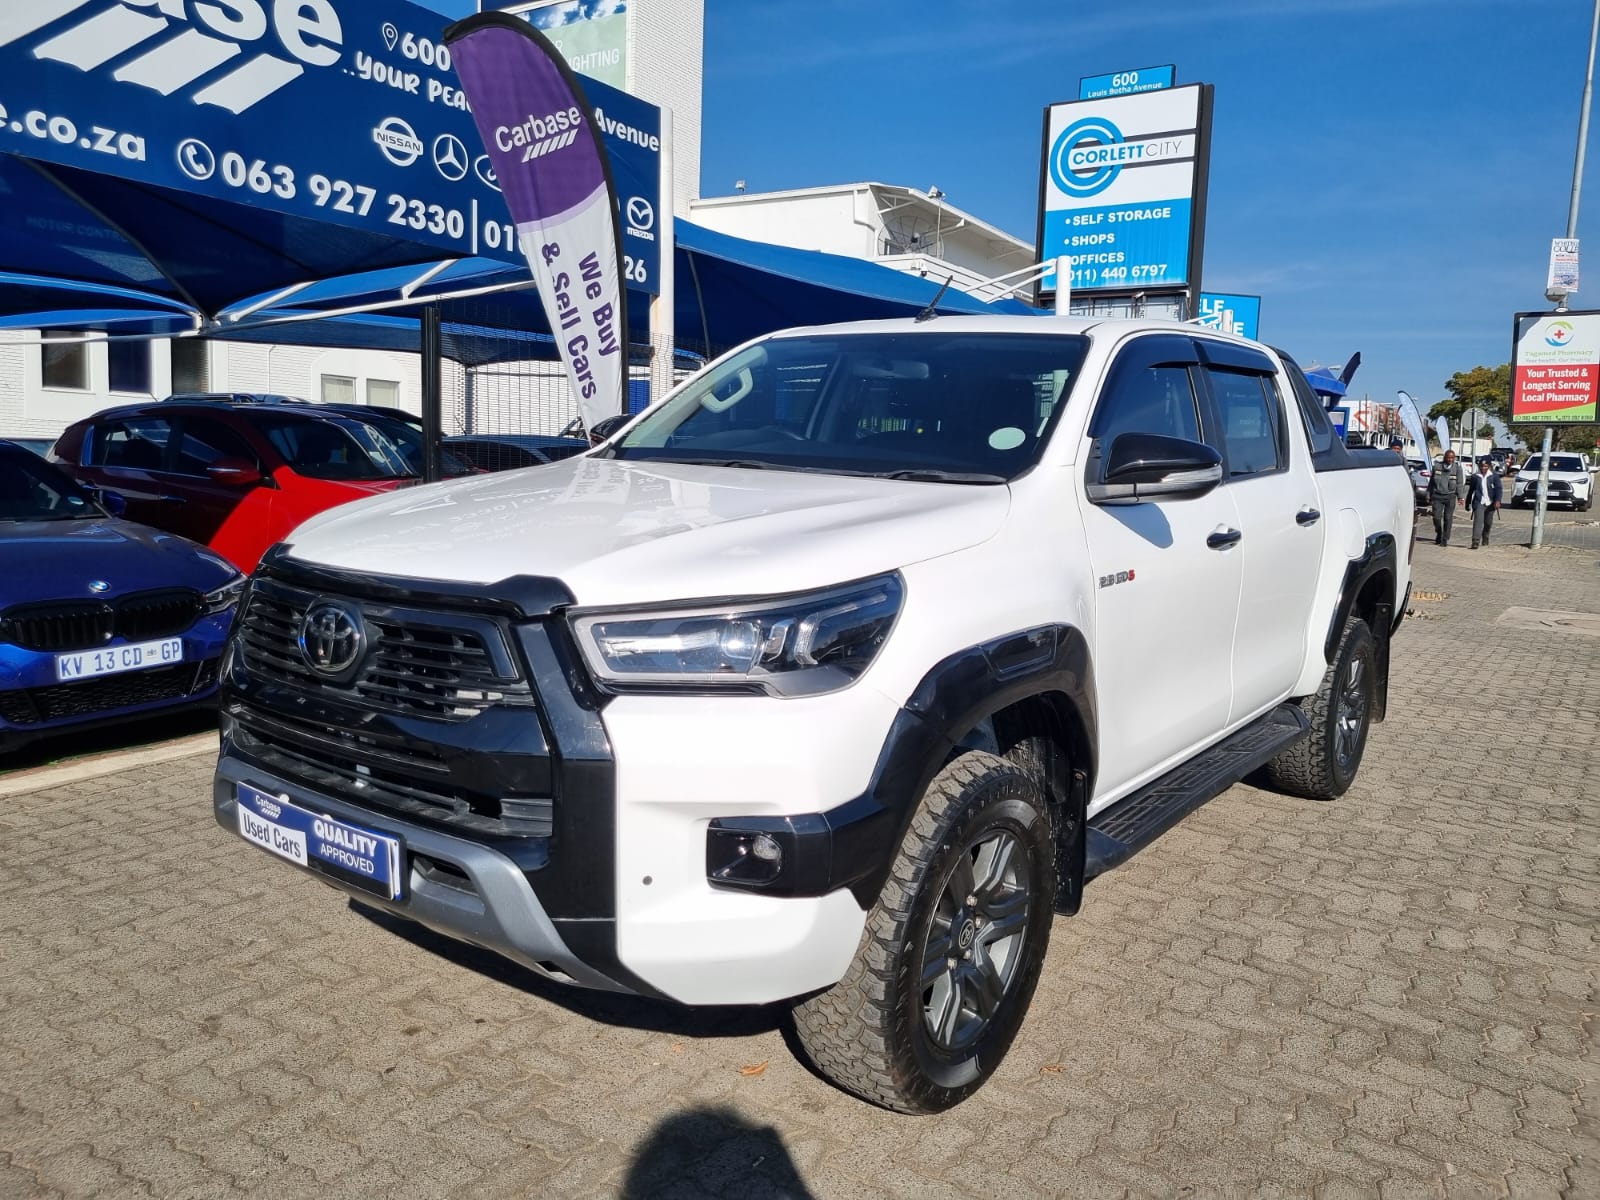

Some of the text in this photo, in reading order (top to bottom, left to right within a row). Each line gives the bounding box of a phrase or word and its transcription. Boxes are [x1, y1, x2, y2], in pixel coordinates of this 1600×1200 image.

[1112, 71, 1139, 87] 600
[403, 33, 660, 150] 600 Avenue
[1087, 83, 1163, 98] Louis Botha Avenue
[495, 105, 581, 153] Carbase
[376, 132, 422, 151] NISSAN
[222, 152, 296, 199] 063
[309, 175, 377, 217] 927
[387, 194, 464, 239] 2330
[484, 219, 526, 256] 01
[1072, 207, 1171, 226] SELF STORAGE
[627, 227, 655, 242] mazda
[1071, 233, 1115, 246] SHOPS
[1071, 252, 1125, 265] OFFICES
[1101, 267, 1127, 278] 440
[1131, 264, 1168, 277] 6797
[578, 251, 620, 356] We Buy
[541, 242, 597, 399] & Sell Cars
[1526, 367, 1588, 378] Your Trusted &
[1522, 380, 1591, 391] Longest Serving
[1522, 392, 1590, 403] Local Pharmacy
[60, 641, 180, 677] KV 13 CD GP
[255, 794, 281, 814] Carbase
[243, 812, 302, 858] Used Cars
[313, 819, 378, 857] QUALITY
[320, 843, 375, 874] APPROVED
